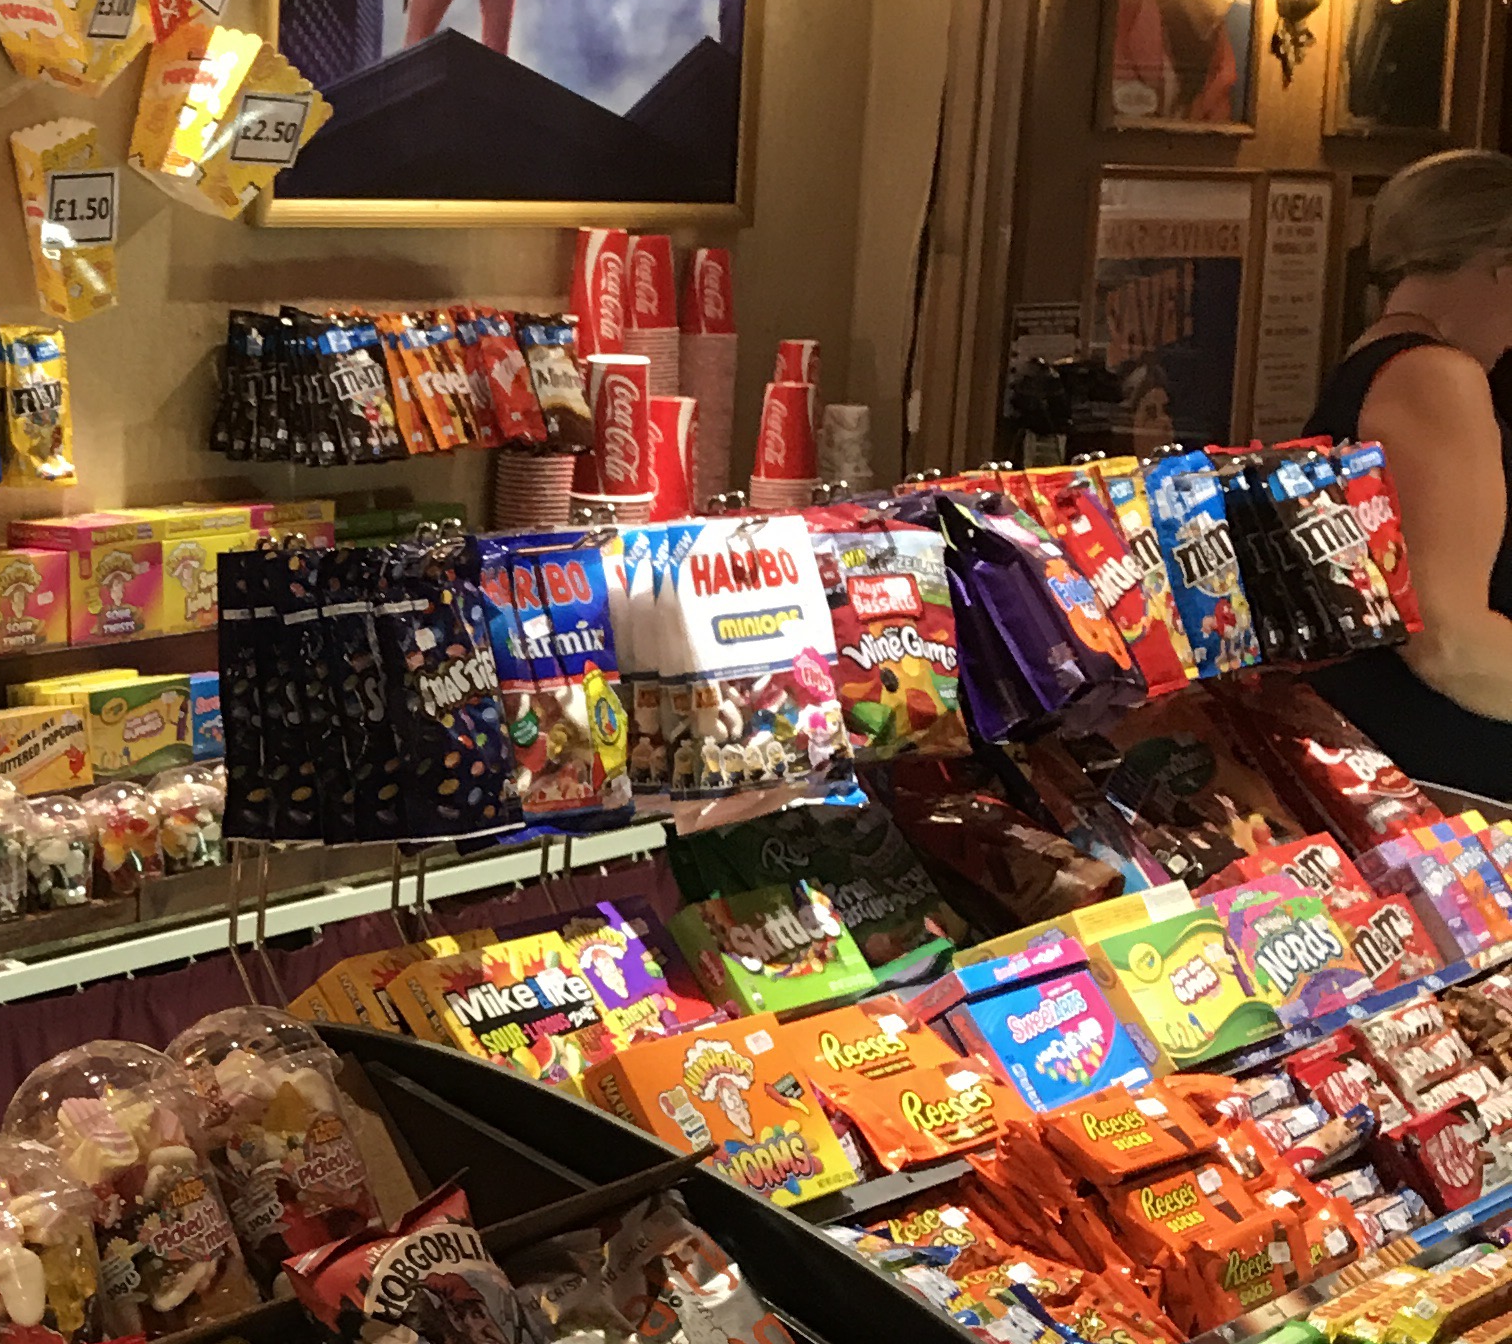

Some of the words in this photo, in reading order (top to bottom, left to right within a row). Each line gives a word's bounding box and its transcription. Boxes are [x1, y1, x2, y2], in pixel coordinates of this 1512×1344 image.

[240, 121, 298, 144] £2.50
[54, 196, 110, 223] £1.50
[444, 981, 537, 1028] Mike
